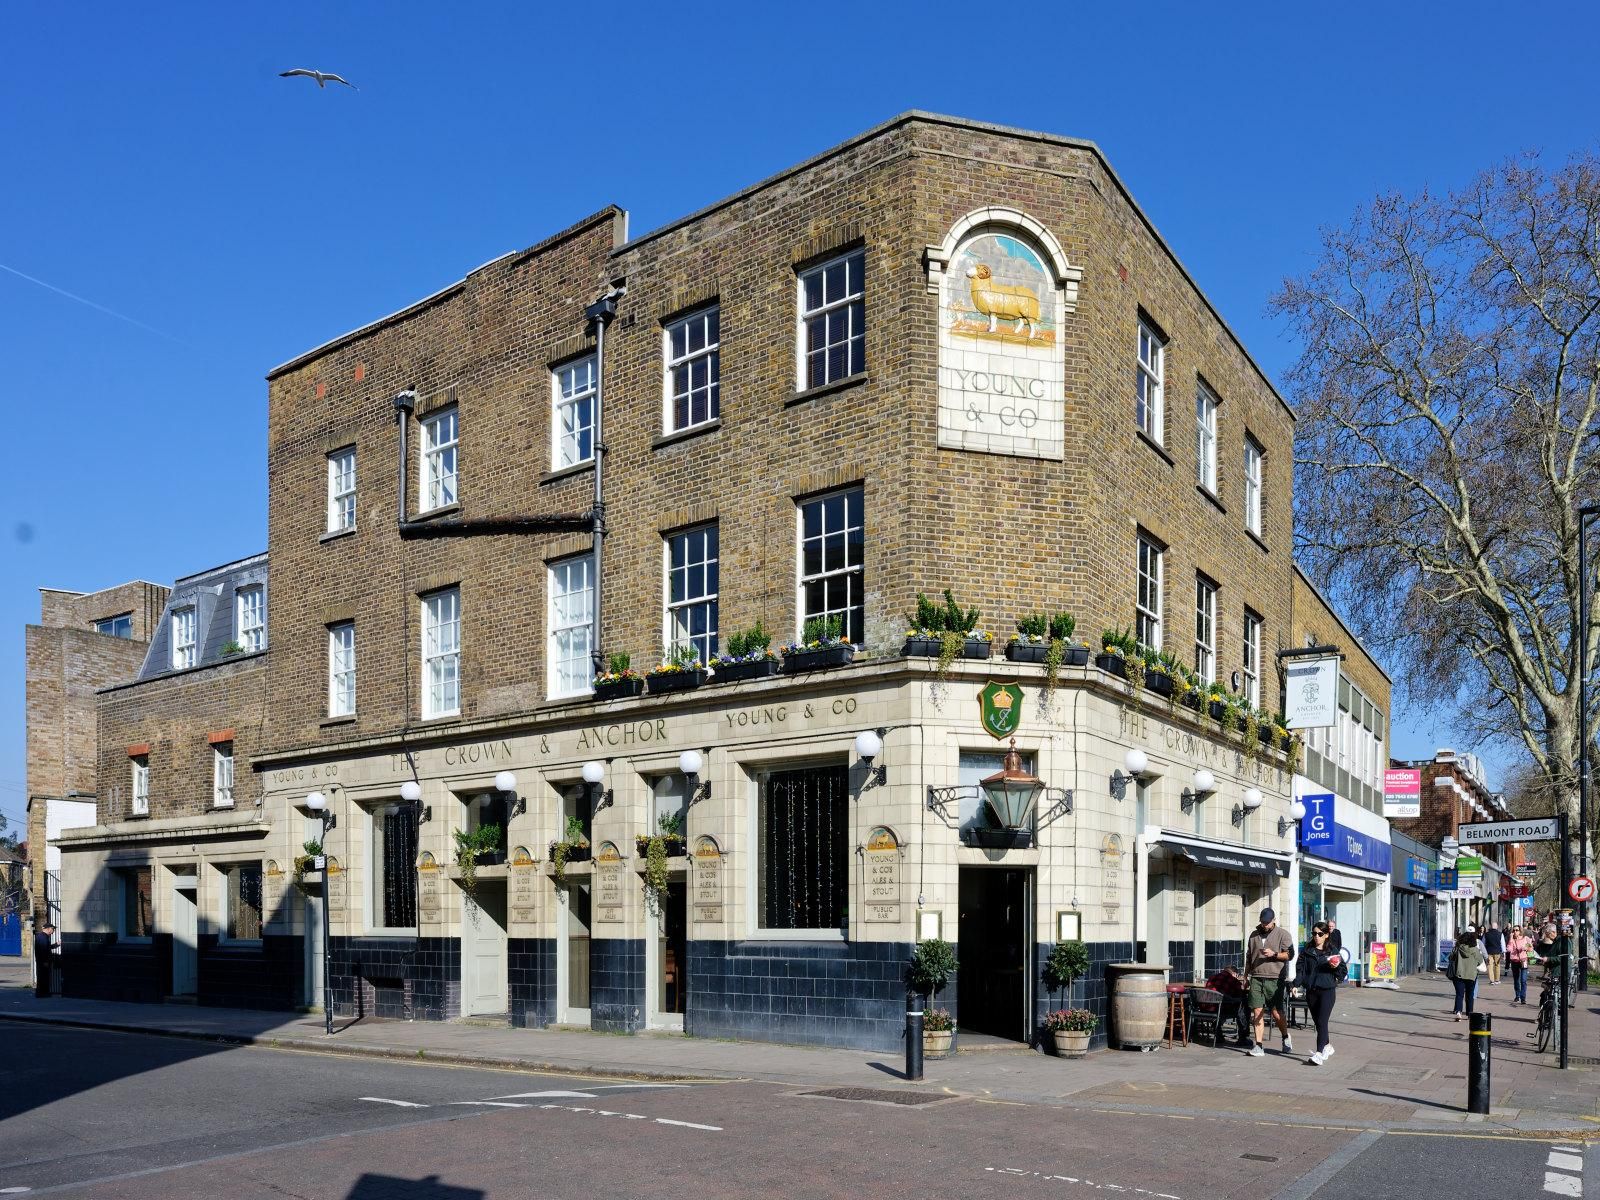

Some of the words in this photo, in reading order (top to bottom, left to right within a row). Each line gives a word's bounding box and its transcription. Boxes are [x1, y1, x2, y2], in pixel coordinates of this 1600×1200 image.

[955, 369, 1046, 399] YOUNG
[966, 402, 984, 424] &
[1000, 406, 1038, 428] CO
[1298, 666, 1326, 675] CROWN
[726, 706, 786, 728] YOUNG
[804, 703, 814, 719] &
[832, 698, 857, 715] CO
[1296, 704, 1328, 712] ANCHOR
[390, 752, 420, 772] THE
[445, 740, 512, 766] CROWN
[540, 734, 550, 754] &
[576, 718, 667, 750] ANCHOR
[1122, 708, 1148, 740] THE
[1166, 728, 1208, 762] CROWN
[1221, 754, 1228, 768] &
[1238, 759, 1274, 786] ANCHOR
[273, 769, 304, 784] YOUNG
[312, 768, 318, 778] &
[325, 765, 338, 776] CO
[1312, 800, 1324, 814] T
[1398, 806, 1418, 814] allsop
[1312, 816, 1324, 830] G
[1306, 832, 1330, 841] Jones
[1466, 828, 1515, 839] BELMONT
[1518, 826, 1550, 836] ROAD
